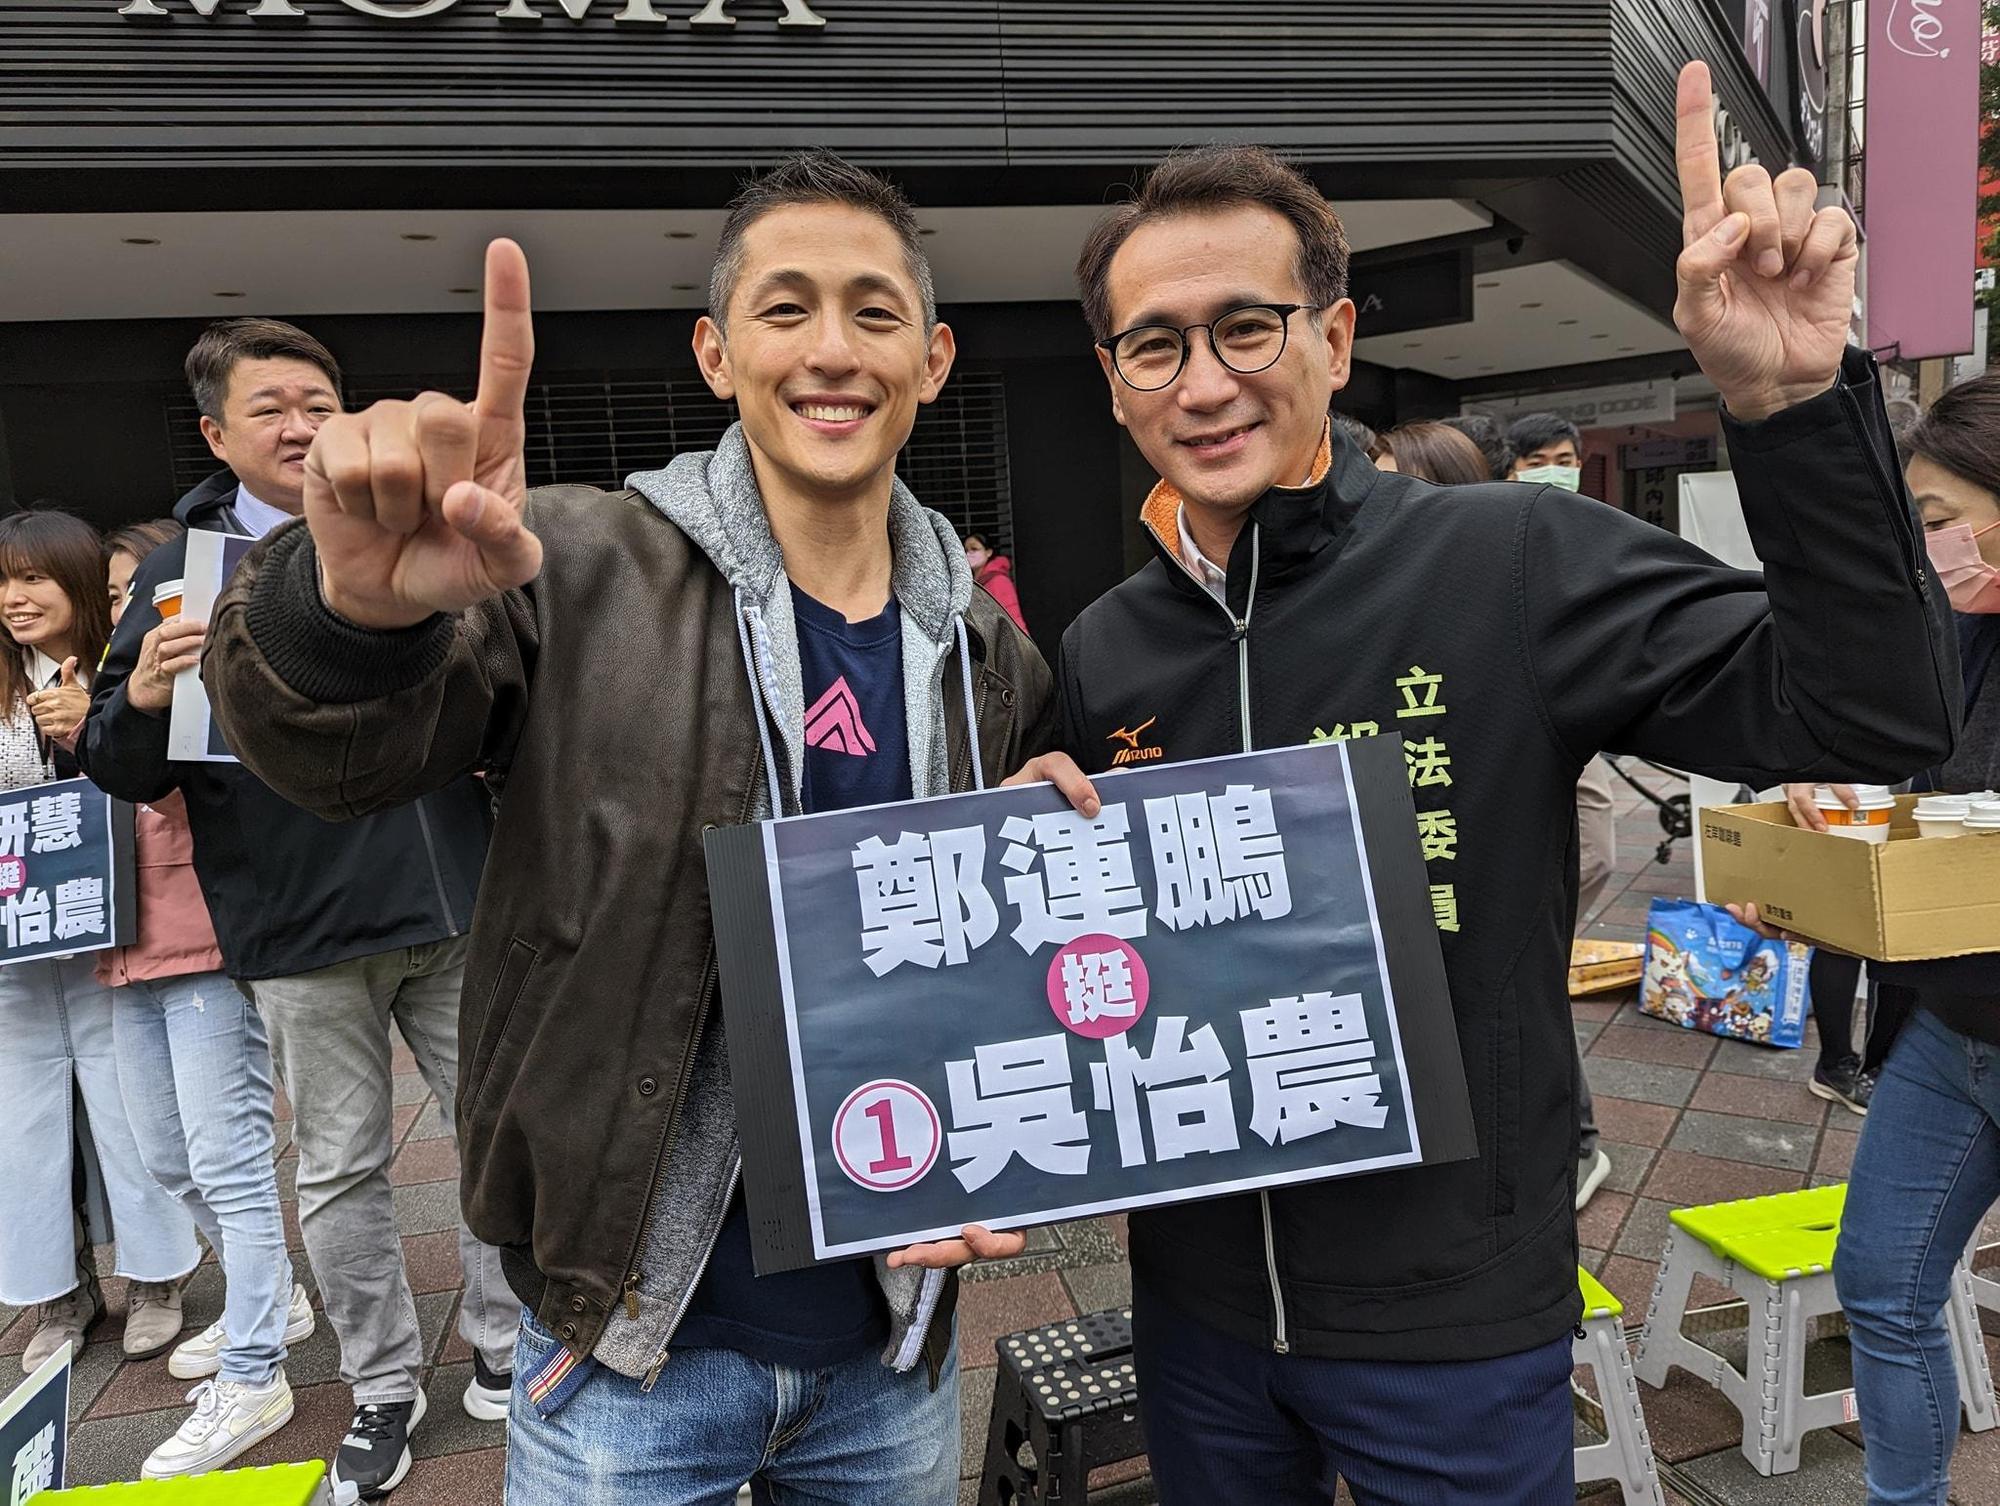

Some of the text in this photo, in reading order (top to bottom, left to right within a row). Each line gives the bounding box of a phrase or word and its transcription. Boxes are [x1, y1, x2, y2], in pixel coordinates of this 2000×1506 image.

[1111, 746, 1163, 766] MIZUNO
[850, 784, 1292, 977] 鄭運鵬
[1060, 948, 1137, 1026] 挺
[865, 990, 1390, 1194] 1 吳怡農
